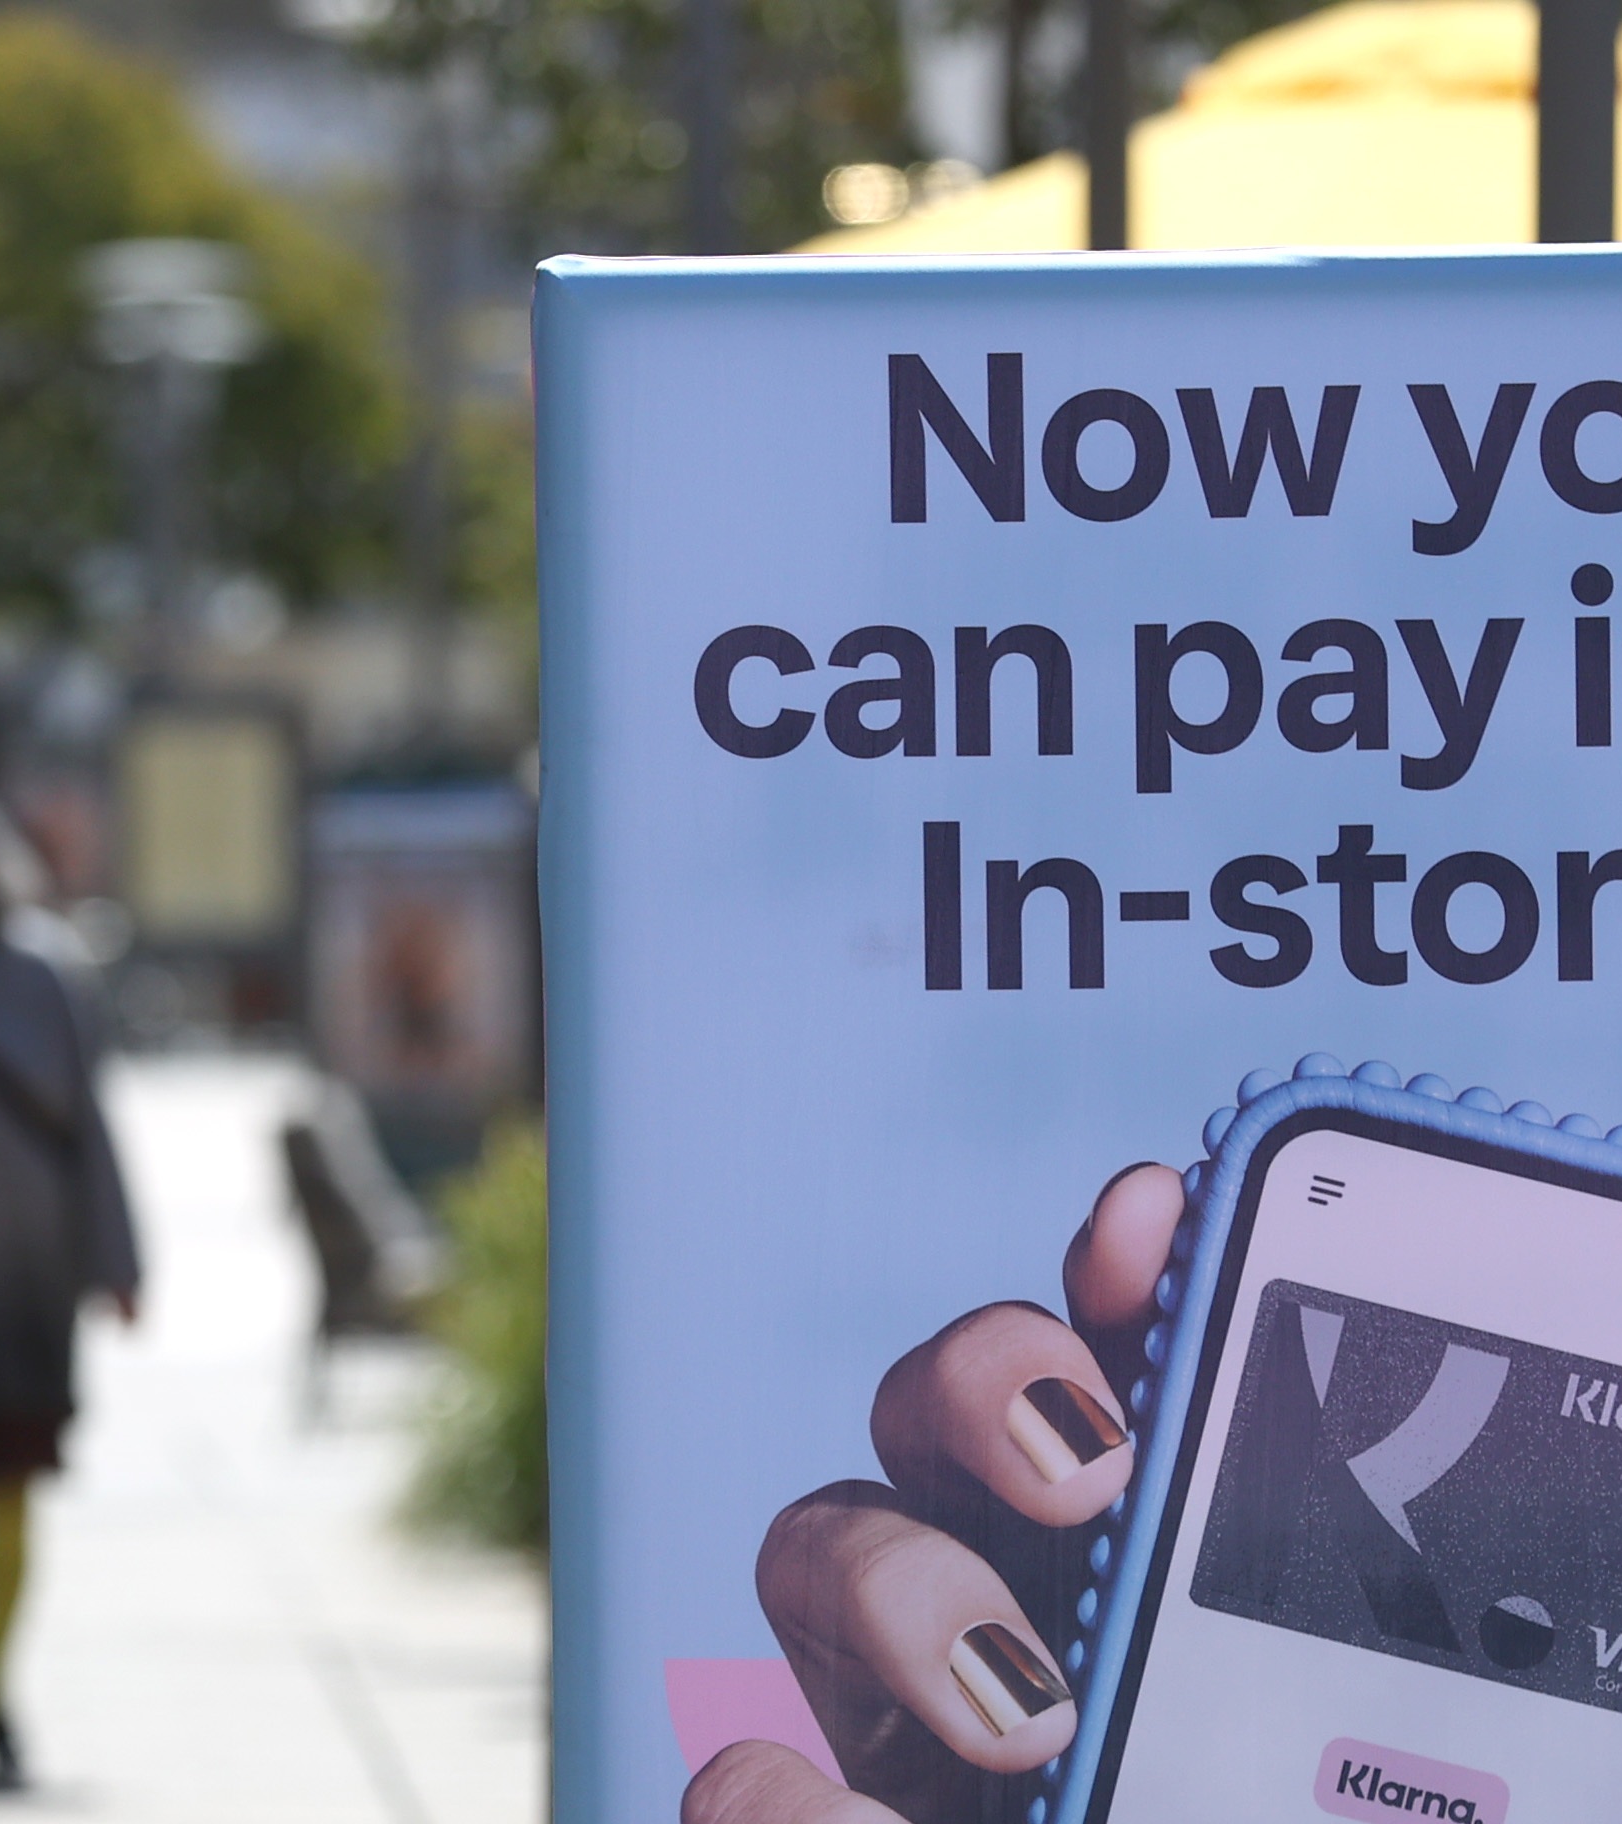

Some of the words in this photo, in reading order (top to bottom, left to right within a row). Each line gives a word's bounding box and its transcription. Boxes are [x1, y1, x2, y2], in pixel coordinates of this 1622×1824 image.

[887, 352, 1362, 524] Now
[693, 623, 1074, 760] can
[1134, 617, 1526, 794] pay
